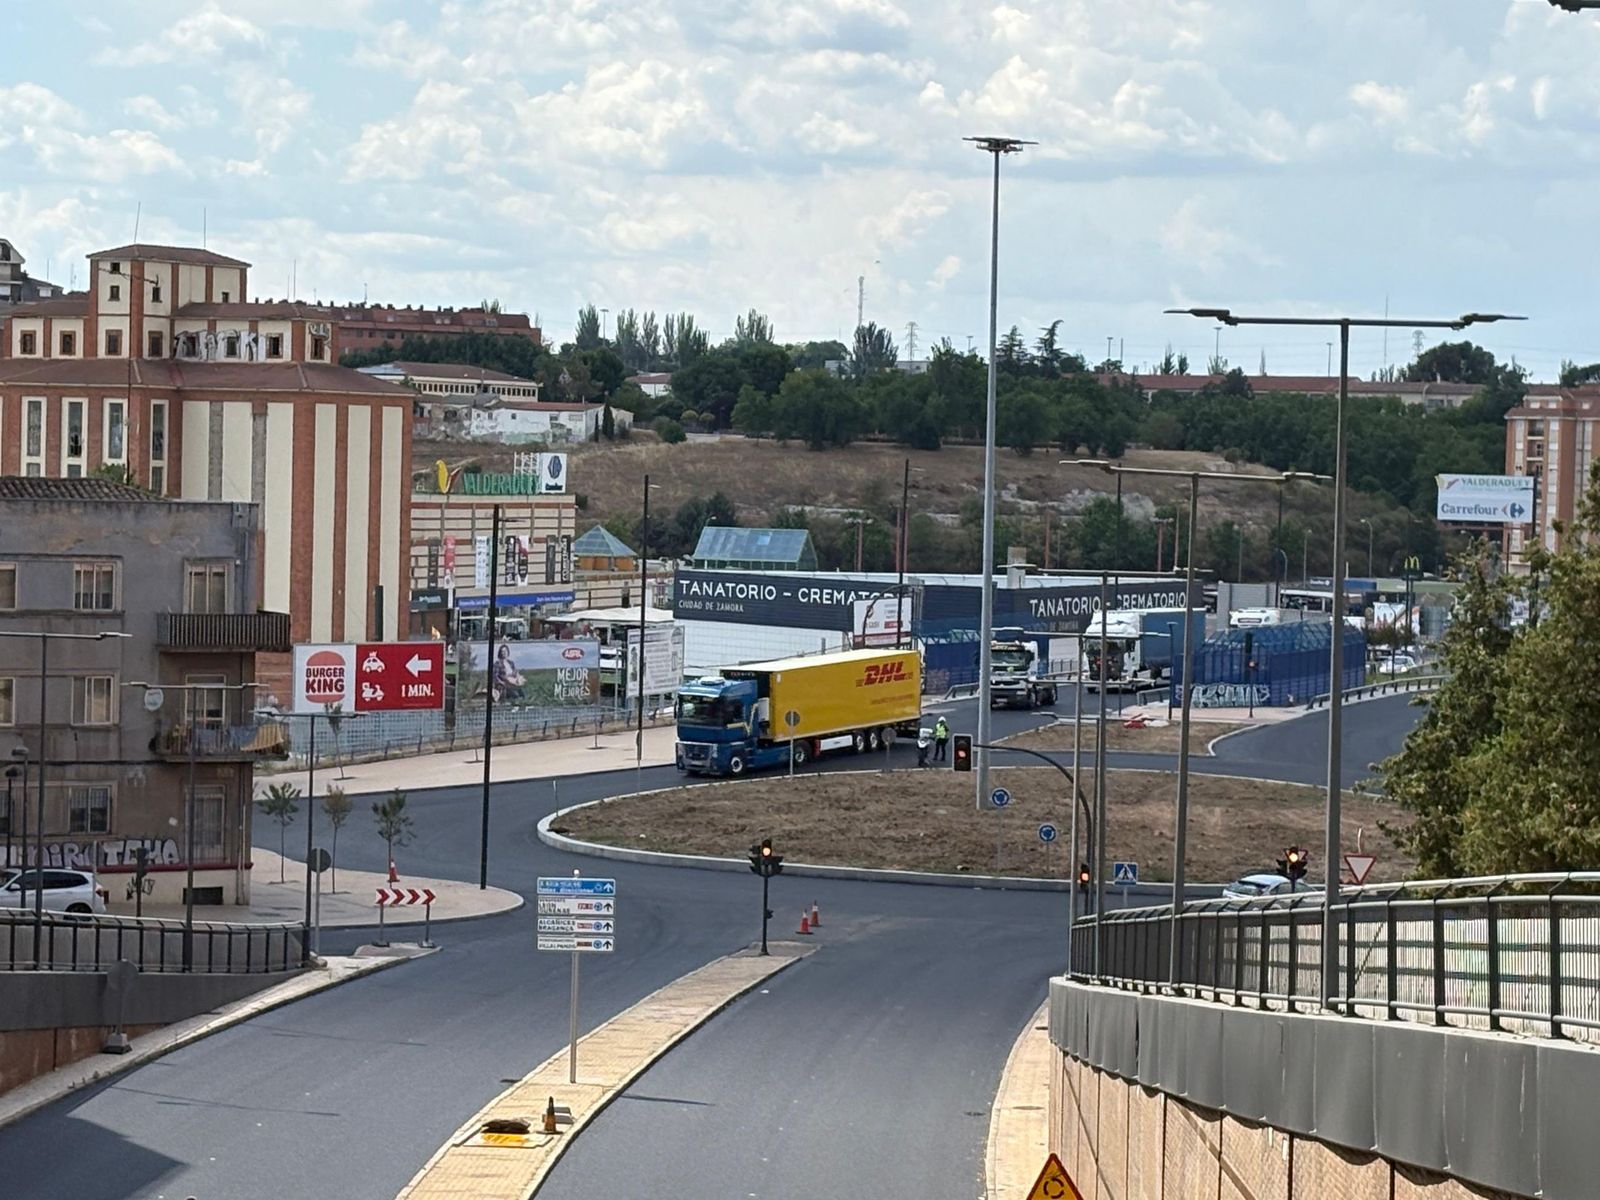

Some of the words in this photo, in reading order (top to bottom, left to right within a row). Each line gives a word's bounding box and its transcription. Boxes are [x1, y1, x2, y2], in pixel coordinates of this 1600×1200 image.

[1461, 477, 1530, 488] VALDERADUEY
[1441, 503, 1499, 516] Carrefour
[679, 579, 777, 601] TANATORIO
[678, 600, 703, 611] CIUDAD
[705, 601, 714, 612] DE
[716, 602, 745, 613] ZAMORA
[1029, 596, 1102, 618] TANATORIO
[305, 667, 345, 678] BURGER
[557, 667, 589, 686] MEJOR
[864, 661, 904, 686] DHL
[305, 679, 345, 694] KING
[408, 684, 435, 698] MIN.
[554, 683, 591, 701] MEJORES
